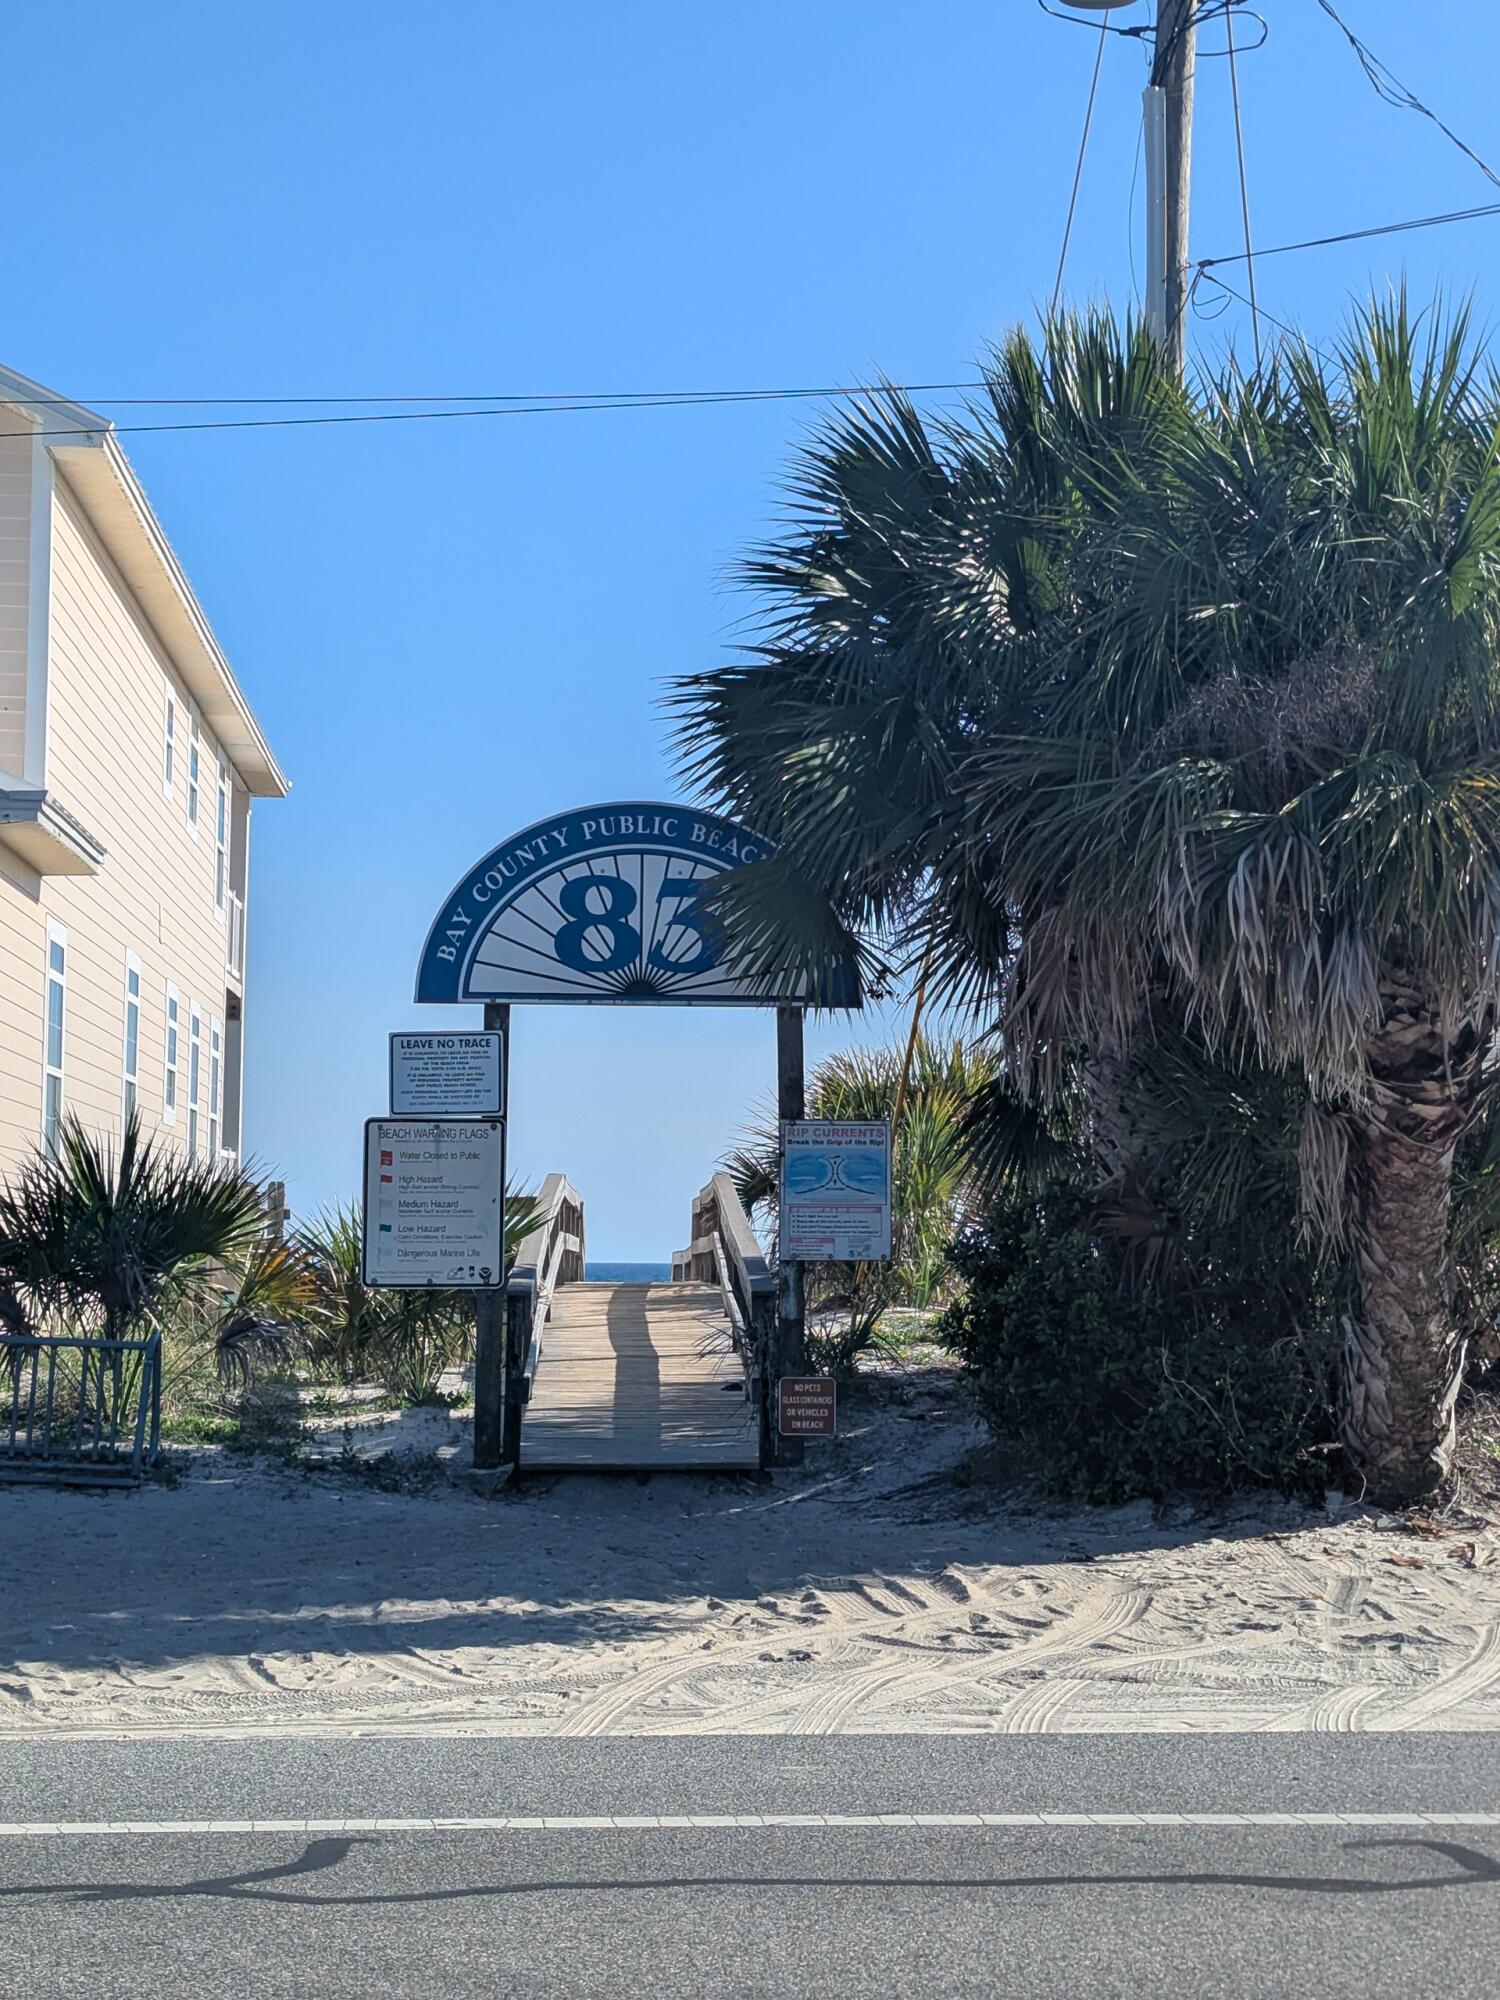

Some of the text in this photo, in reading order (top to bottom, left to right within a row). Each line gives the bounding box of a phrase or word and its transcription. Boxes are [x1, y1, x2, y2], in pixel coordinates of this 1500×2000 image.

[437, 815, 768, 963] BAY COUNTY PUBLIC BEAC
[553, 874, 728, 973] 83
[400, 1038, 492, 1049] LEAVE NO TRACE
[379, 1128, 411, 1139] BEACH
[459, 1128, 489, 1139] FLAGS
[787, 1128, 884, 1138] RIP CURRENTS
[826, 1139, 843, 1147] Grip
[399, 1151, 481, 1160] Water Closed to Public
[398, 1175, 443, 1185] High Hazard
[398, 1199, 459, 1208] Medium Hazard
[397, 1224, 446, 1233] Low Hazard
[397, 1248, 480, 1258] Dangerous Marine Life
[794, 1384, 822, 1392] NO PETS
[782, 1396, 833, 1404] GLASS CONTAINERS
[786, 1408, 829, 1416] OR VEHICLES
[791, 1420, 824, 1429] ON BEACH
